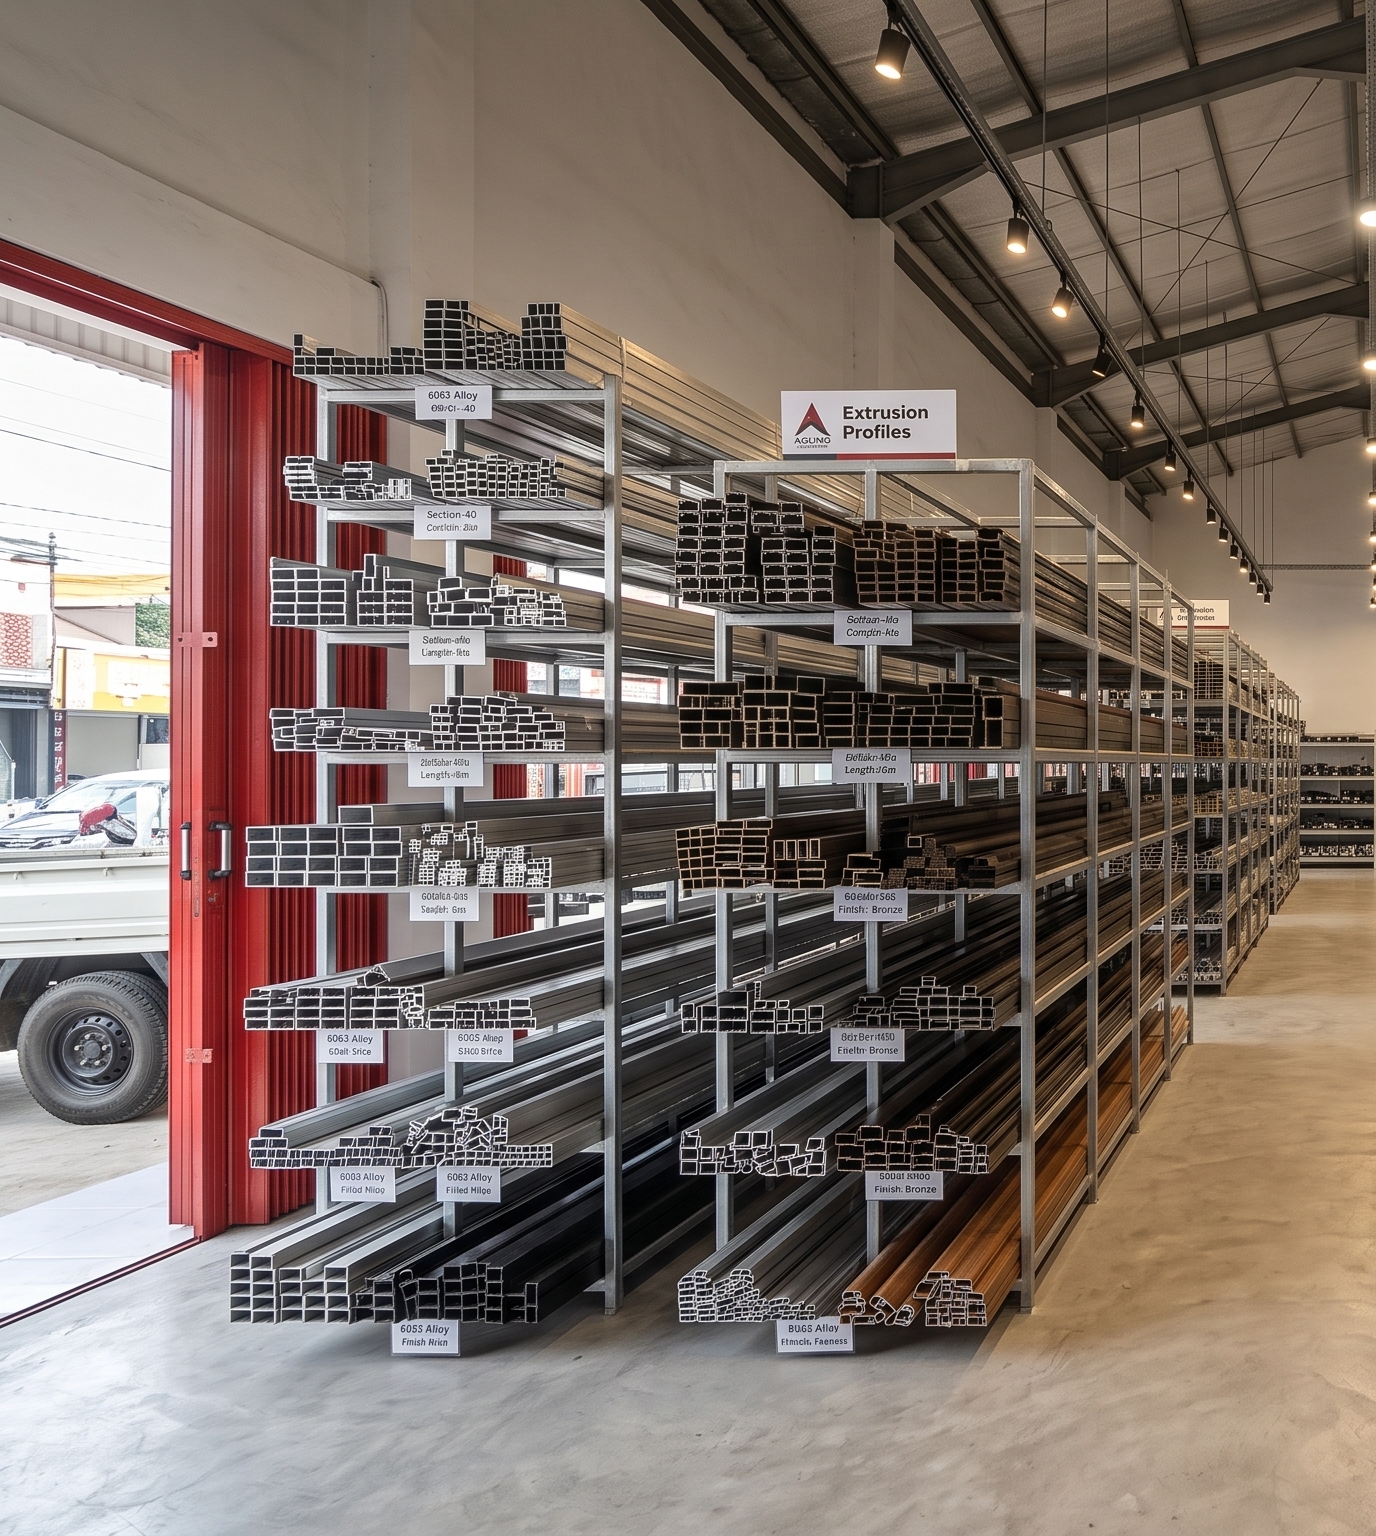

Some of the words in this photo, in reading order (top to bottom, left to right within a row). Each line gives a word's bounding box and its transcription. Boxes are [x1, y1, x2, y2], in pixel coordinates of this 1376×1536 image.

[428, 391, 451, 399] 6063
[454, 391, 478, 401] Alloy
[843, 405, 929, 420] Extrusion
[843, 424, 912, 440] Profiles
[427, 510, 477, 519] Section-40
[872, 906, 903, 914] Bronze
[362, 1173, 386, 1183] Alloy
